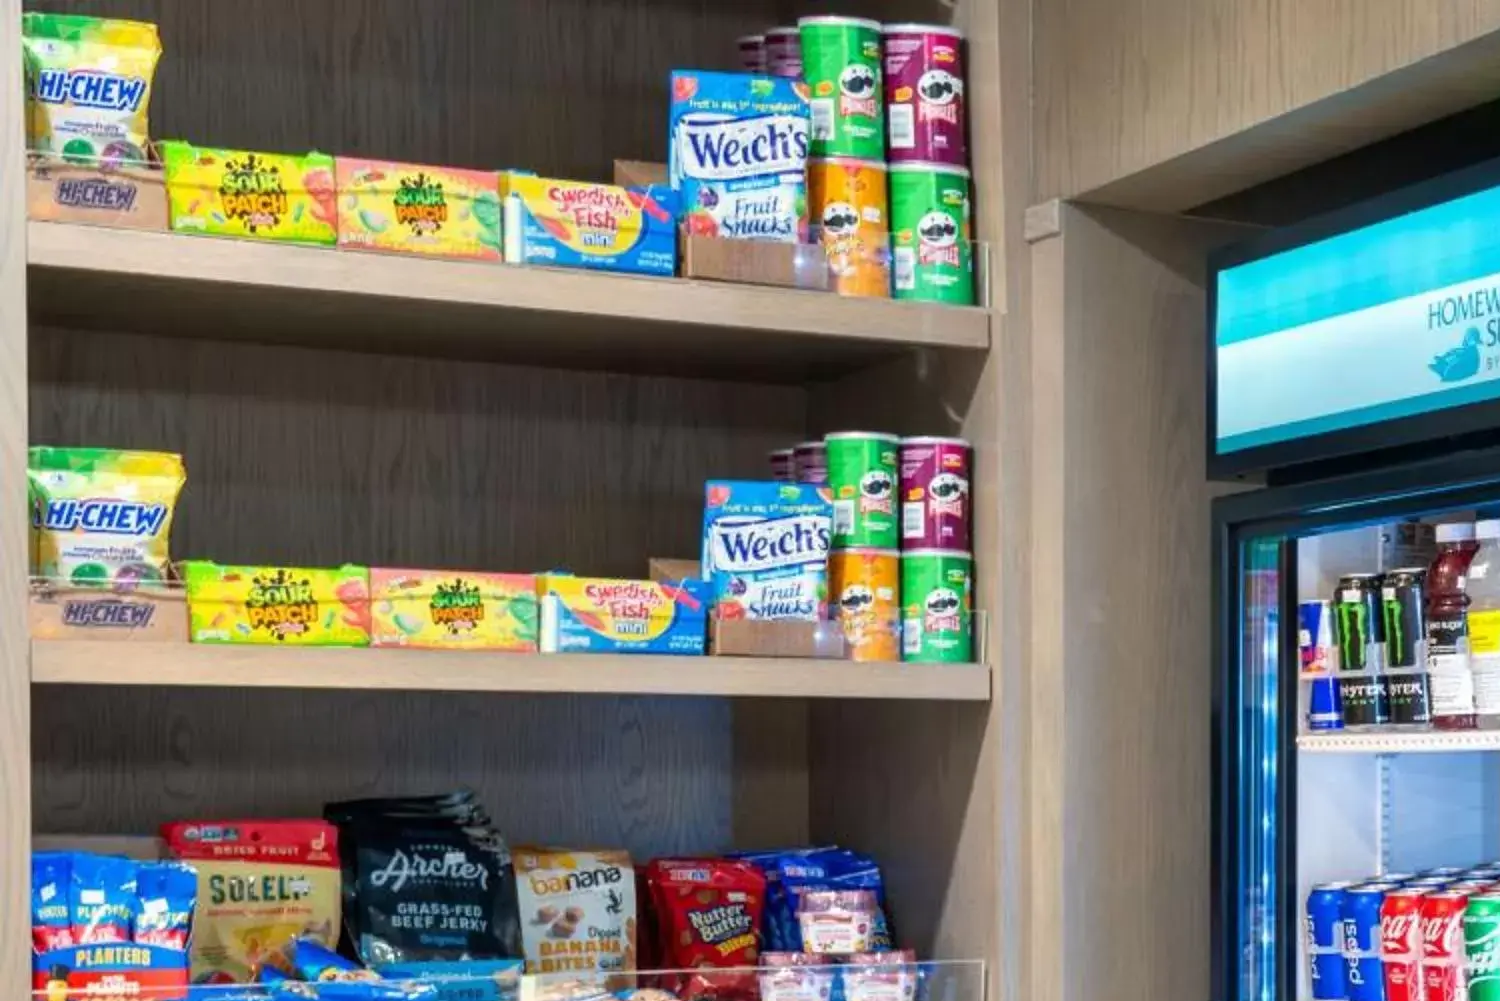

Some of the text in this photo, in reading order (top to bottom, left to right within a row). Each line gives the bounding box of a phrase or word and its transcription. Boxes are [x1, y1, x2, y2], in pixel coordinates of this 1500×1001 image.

[38, 70, 147, 112] HI-CHEW
[573, 207, 617, 230] Fish
[46, 500, 167, 536] HI-CHEW
[608, 600, 651, 620] Fish
[212, 845, 301, 857] DRIED FRUIT
[370, 847, 490, 894] Archer
[396, 902, 483, 918] GRASS-FED
[687, 903, 745, 931] Nutter
[391, 915, 489, 934] BEEF JERKY
[697, 916, 753, 943] Butter
[74, 947, 152, 968] PLANTERS
[1343, 918, 1366, 986] pepsi
